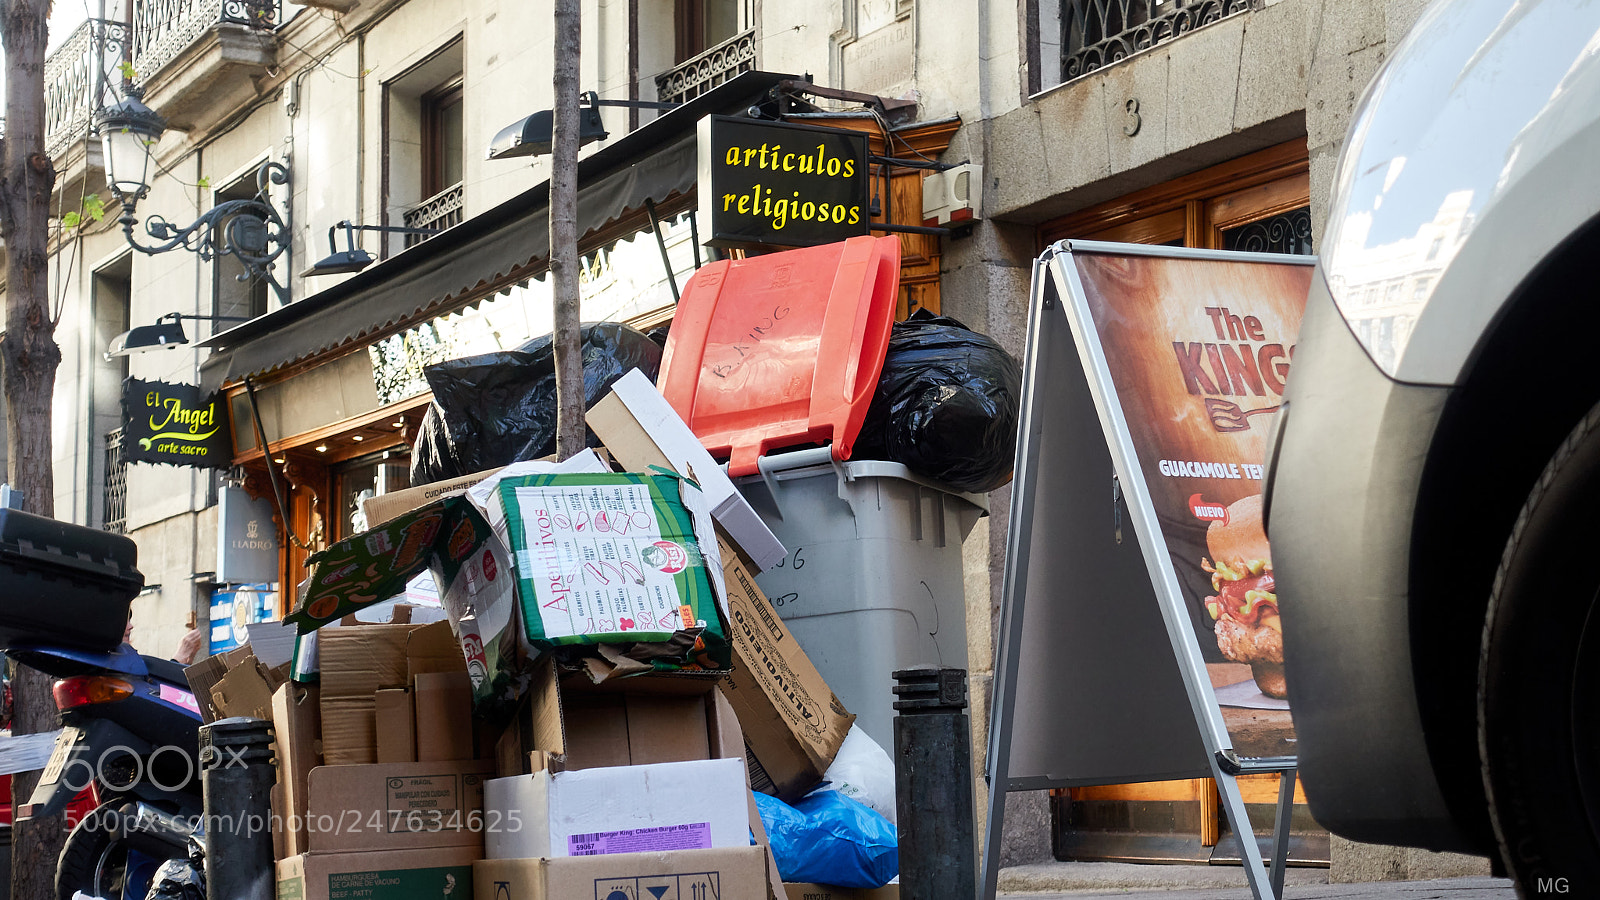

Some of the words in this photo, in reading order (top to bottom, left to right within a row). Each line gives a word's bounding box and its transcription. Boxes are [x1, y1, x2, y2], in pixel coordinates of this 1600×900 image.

[1123, 98, 1141, 137] 3
[725, 142, 855, 178] artículos
[722, 184, 860, 230] religiosos
[1205, 306, 1265, 341] The
[1172, 341, 1296, 396] KING
[146, 391, 160, 408] El
[149, 398, 215, 434] Angel
[157, 442, 178, 454] arte
[180, 446, 208, 456] sacro
[1159, 460, 1241, 479] GUACAMOLE
[1194, 506, 1225, 518] NUEVO
[534, 508, 572, 614] Aperitivos
[735, 610, 813, 720] ALTIVOLEICO
[600, 831, 618, 839] Burger
[636, 826, 658, 835] Chicken
[659, 825, 677, 833] Burger
[331, 881, 340, 889] DE
[341, 880, 363, 888] CARNE
[364, 879, 374, 887] DE
[374, 878, 400, 886] VACUNO
[332, 891, 347, 899] BEEF
[353, 889, 373, 897] PATTY
